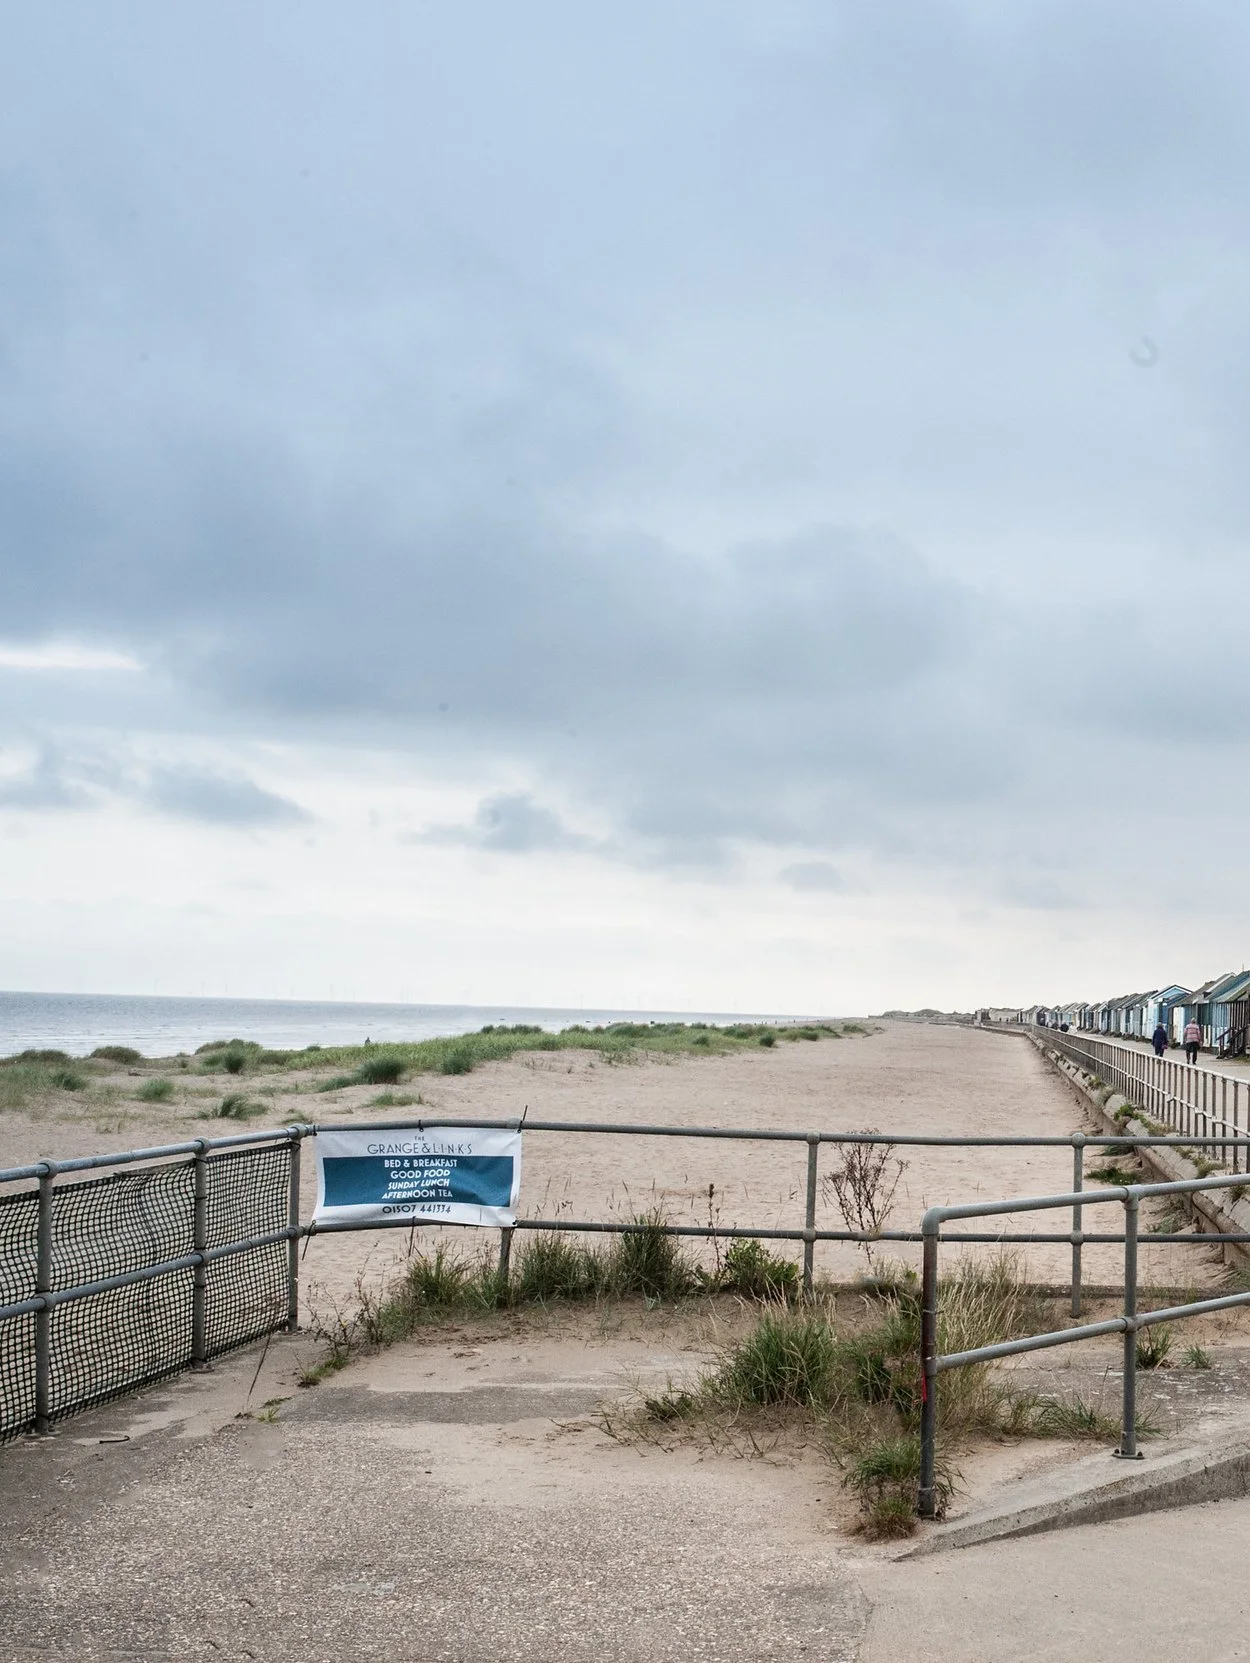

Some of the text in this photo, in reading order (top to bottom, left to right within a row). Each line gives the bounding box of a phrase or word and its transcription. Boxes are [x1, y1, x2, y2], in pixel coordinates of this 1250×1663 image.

[367, 1143, 418, 1154] GRANGE
[422, 1143, 430, 1153] &
[413, 1159, 458, 1167] BREAKFAST
[391, 1169, 450, 1179] GOOD FOOD
[388, 1180, 419, 1190] SUNDAY
[382, 1190, 435, 1199] AFTERNOON
[382, 1204, 451, 1213] 01507 441334
